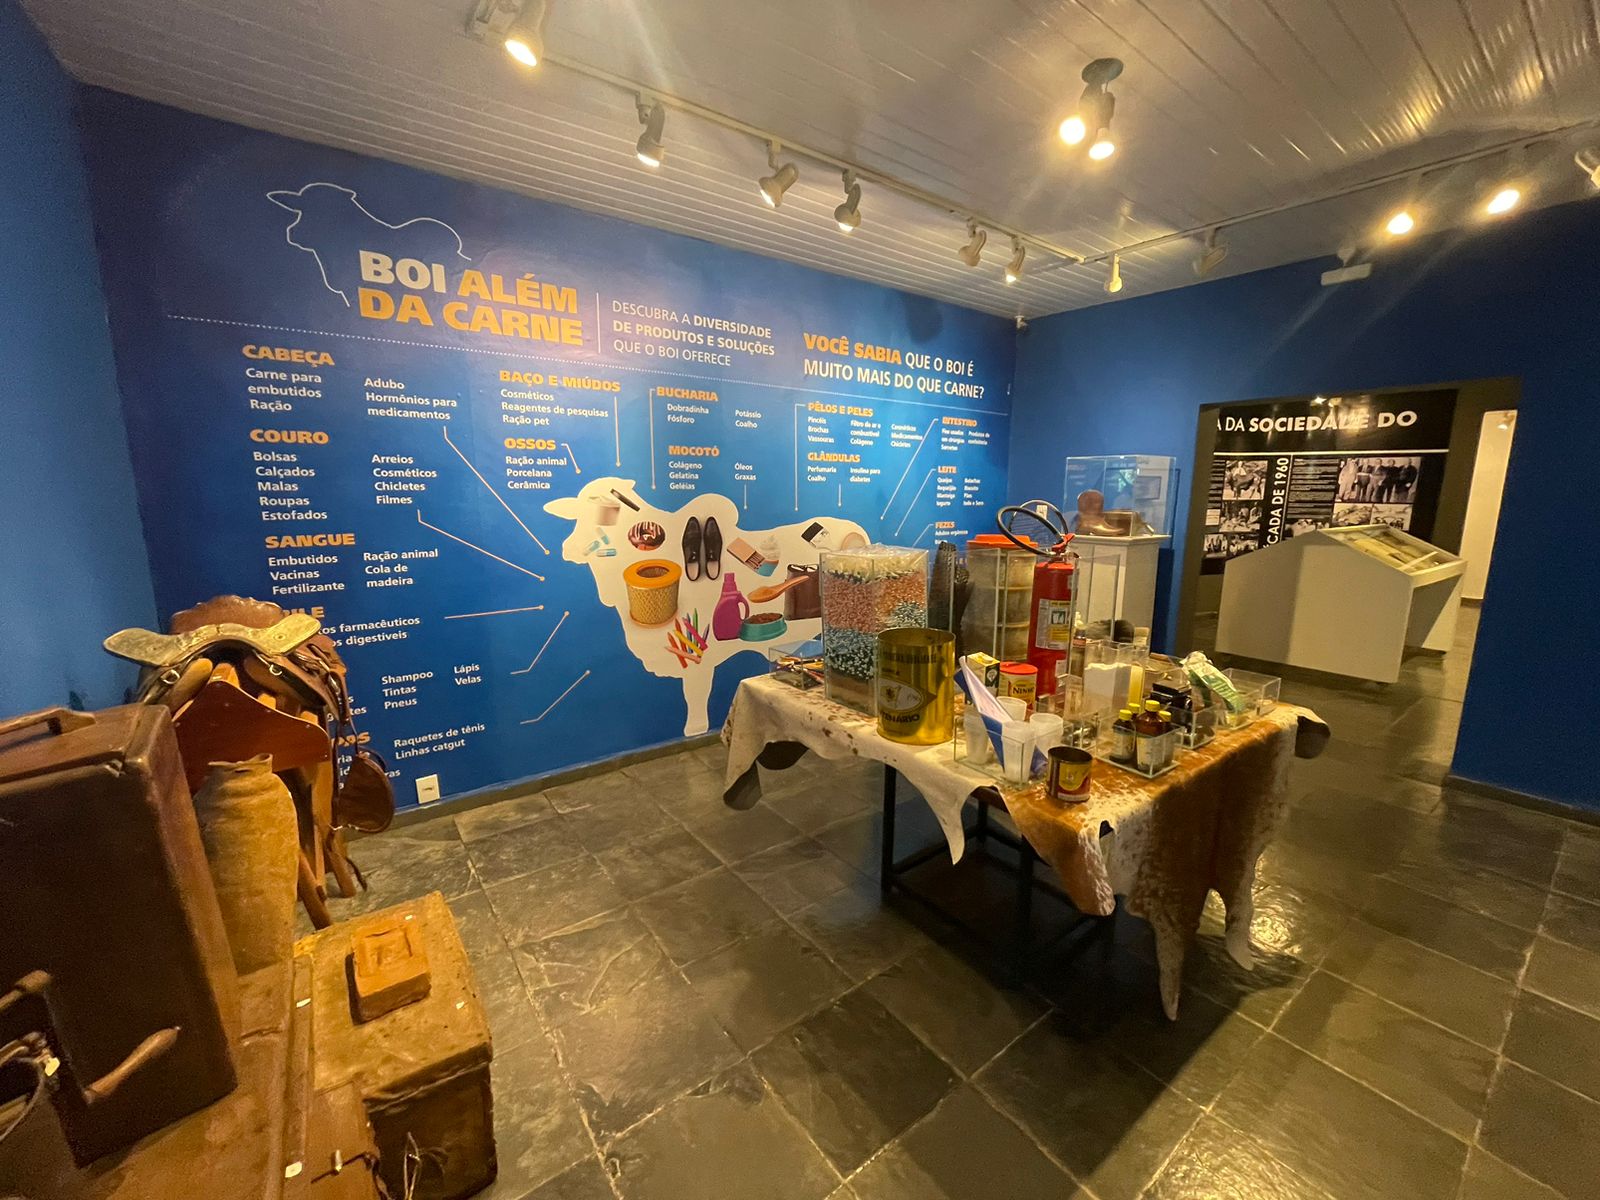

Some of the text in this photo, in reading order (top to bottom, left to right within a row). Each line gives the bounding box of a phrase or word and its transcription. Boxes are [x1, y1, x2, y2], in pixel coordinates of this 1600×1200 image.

[359, 250, 577, 313] BOI ALÉM
[358, 287, 583, 346] DA CARNE
[612, 300, 771, 339] DESCUBRA A DIVERSIDADE
[613, 320, 775, 356] DE PRODUTOS E SOLUÇÕES
[242, 345, 335, 368] CABEÇA
[613, 339, 731, 366] QUE O BOI OFERECE
[803, 333, 974, 377] VOCÊ SABIA QUE O BOI É
[246, 368, 322, 383] Carne para
[500, 370, 621, 392] BAÇO E MIÚDOS
[804, 359, 985, 399] MUITO MAIS DO QUE CARNE?
[364, 378, 405, 389] Adubo
[248, 385, 322, 398] embutidos
[501, 388, 554, 401] Cosméticos
[657, 386, 719, 402] BUCHARIA
[250, 399, 292, 412] Ração
[366, 392, 457, 407] Hormônios para
[367, 407, 451, 420] medicamentos
[501, 401, 609, 418] Reagentes de pesquisas
[667, 403, 709, 414] Dobradinha
[735, 409, 762, 419] Potássio
[808, 401, 874, 417] PÊLOS E PELES
[502, 415, 550, 426] Ração pet
[667, 414, 695, 424] Fósforo
[735, 420, 758, 429] Coalho
[1225, 416, 1245, 432] DA
[1377, 410, 1418, 428] DO
[250, 428, 329, 445] COURO
[504, 438, 556, 451] OSSOS
[253, 451, 297, 462] Bolsas
[668, 445, 720, 457] MOCOTÓ
[808, 450, 861, 463] GLÂNDULAS
[372, 454, 414, 464] Arreios
[505, 456, 567, 466] Ração animal
[256, 466, 315, 478] Calçados
[668, 461, 702, 471] Colágeno
[373, 467, 437, 478] Cosméticos
[506, 468, 552, 478] Porcelana
[669, 472, 699, 480] Gelatina
[734, 473, 757, 481] Graxas
[258, 481, 299, 491] Malas
[374, 481, 426, 491] Chicletes
[507, 480, 551, 489] Cerâmica
[669, 482, 696, 490] Geléias
[259, 496, 310, 508] Roupas
[376, 495, 413, 504] Filmes
[1263, 457, 1289, 548] CADA DE 1960
[262, 510, 328, 521] Estofados
[265, 533, 356, 549] SANGUE
[268, 555, 338, 567] Embutidos
[363, 548, 439, 562] Ração animal
[270, 570, 320, 581] Vacinas
[365, 564, 408, 575] Cola de
[366, 576, 413, 588] madeira
[272, 582, 345, 595] Fertilizante
[340, 617, 421, 632] farmacêuticos
[346, 630, 408, 646] digestíveis
[454, 663, 480, 674] Lápis
[381, 671, 433, 685] Shampoo
[455, 675, 482, 685] Velas
[382, 686, 417, 697] Tintas
[384, 698, 418, 709] Pneus
[394, 723, 485, 748] Raquetes de tênis
[395, 739, 466, 760] Linhas catgut
